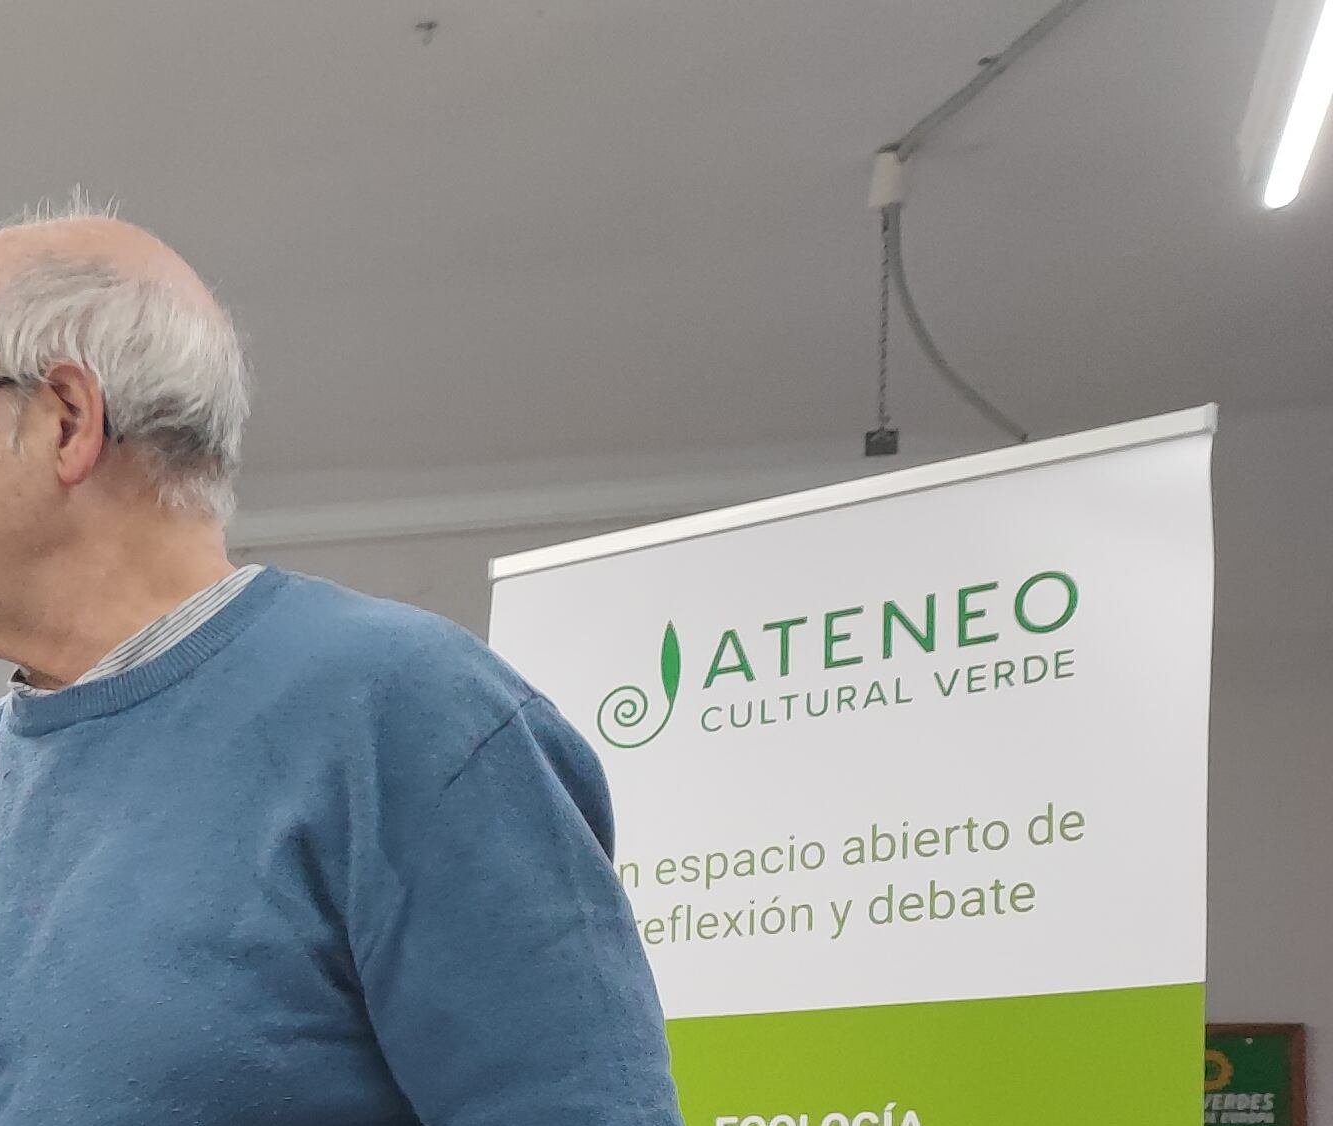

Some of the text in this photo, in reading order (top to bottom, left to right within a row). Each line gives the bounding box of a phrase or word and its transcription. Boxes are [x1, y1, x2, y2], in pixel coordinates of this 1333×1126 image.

[703, 570, 1080, 689] ATENEO
[700, 648, 1078, 733] CULTURAL VERDE
[620, 802, 1086, 890] n espacio abierto de
[637, 875, 1037, 946] eflexión y debate
